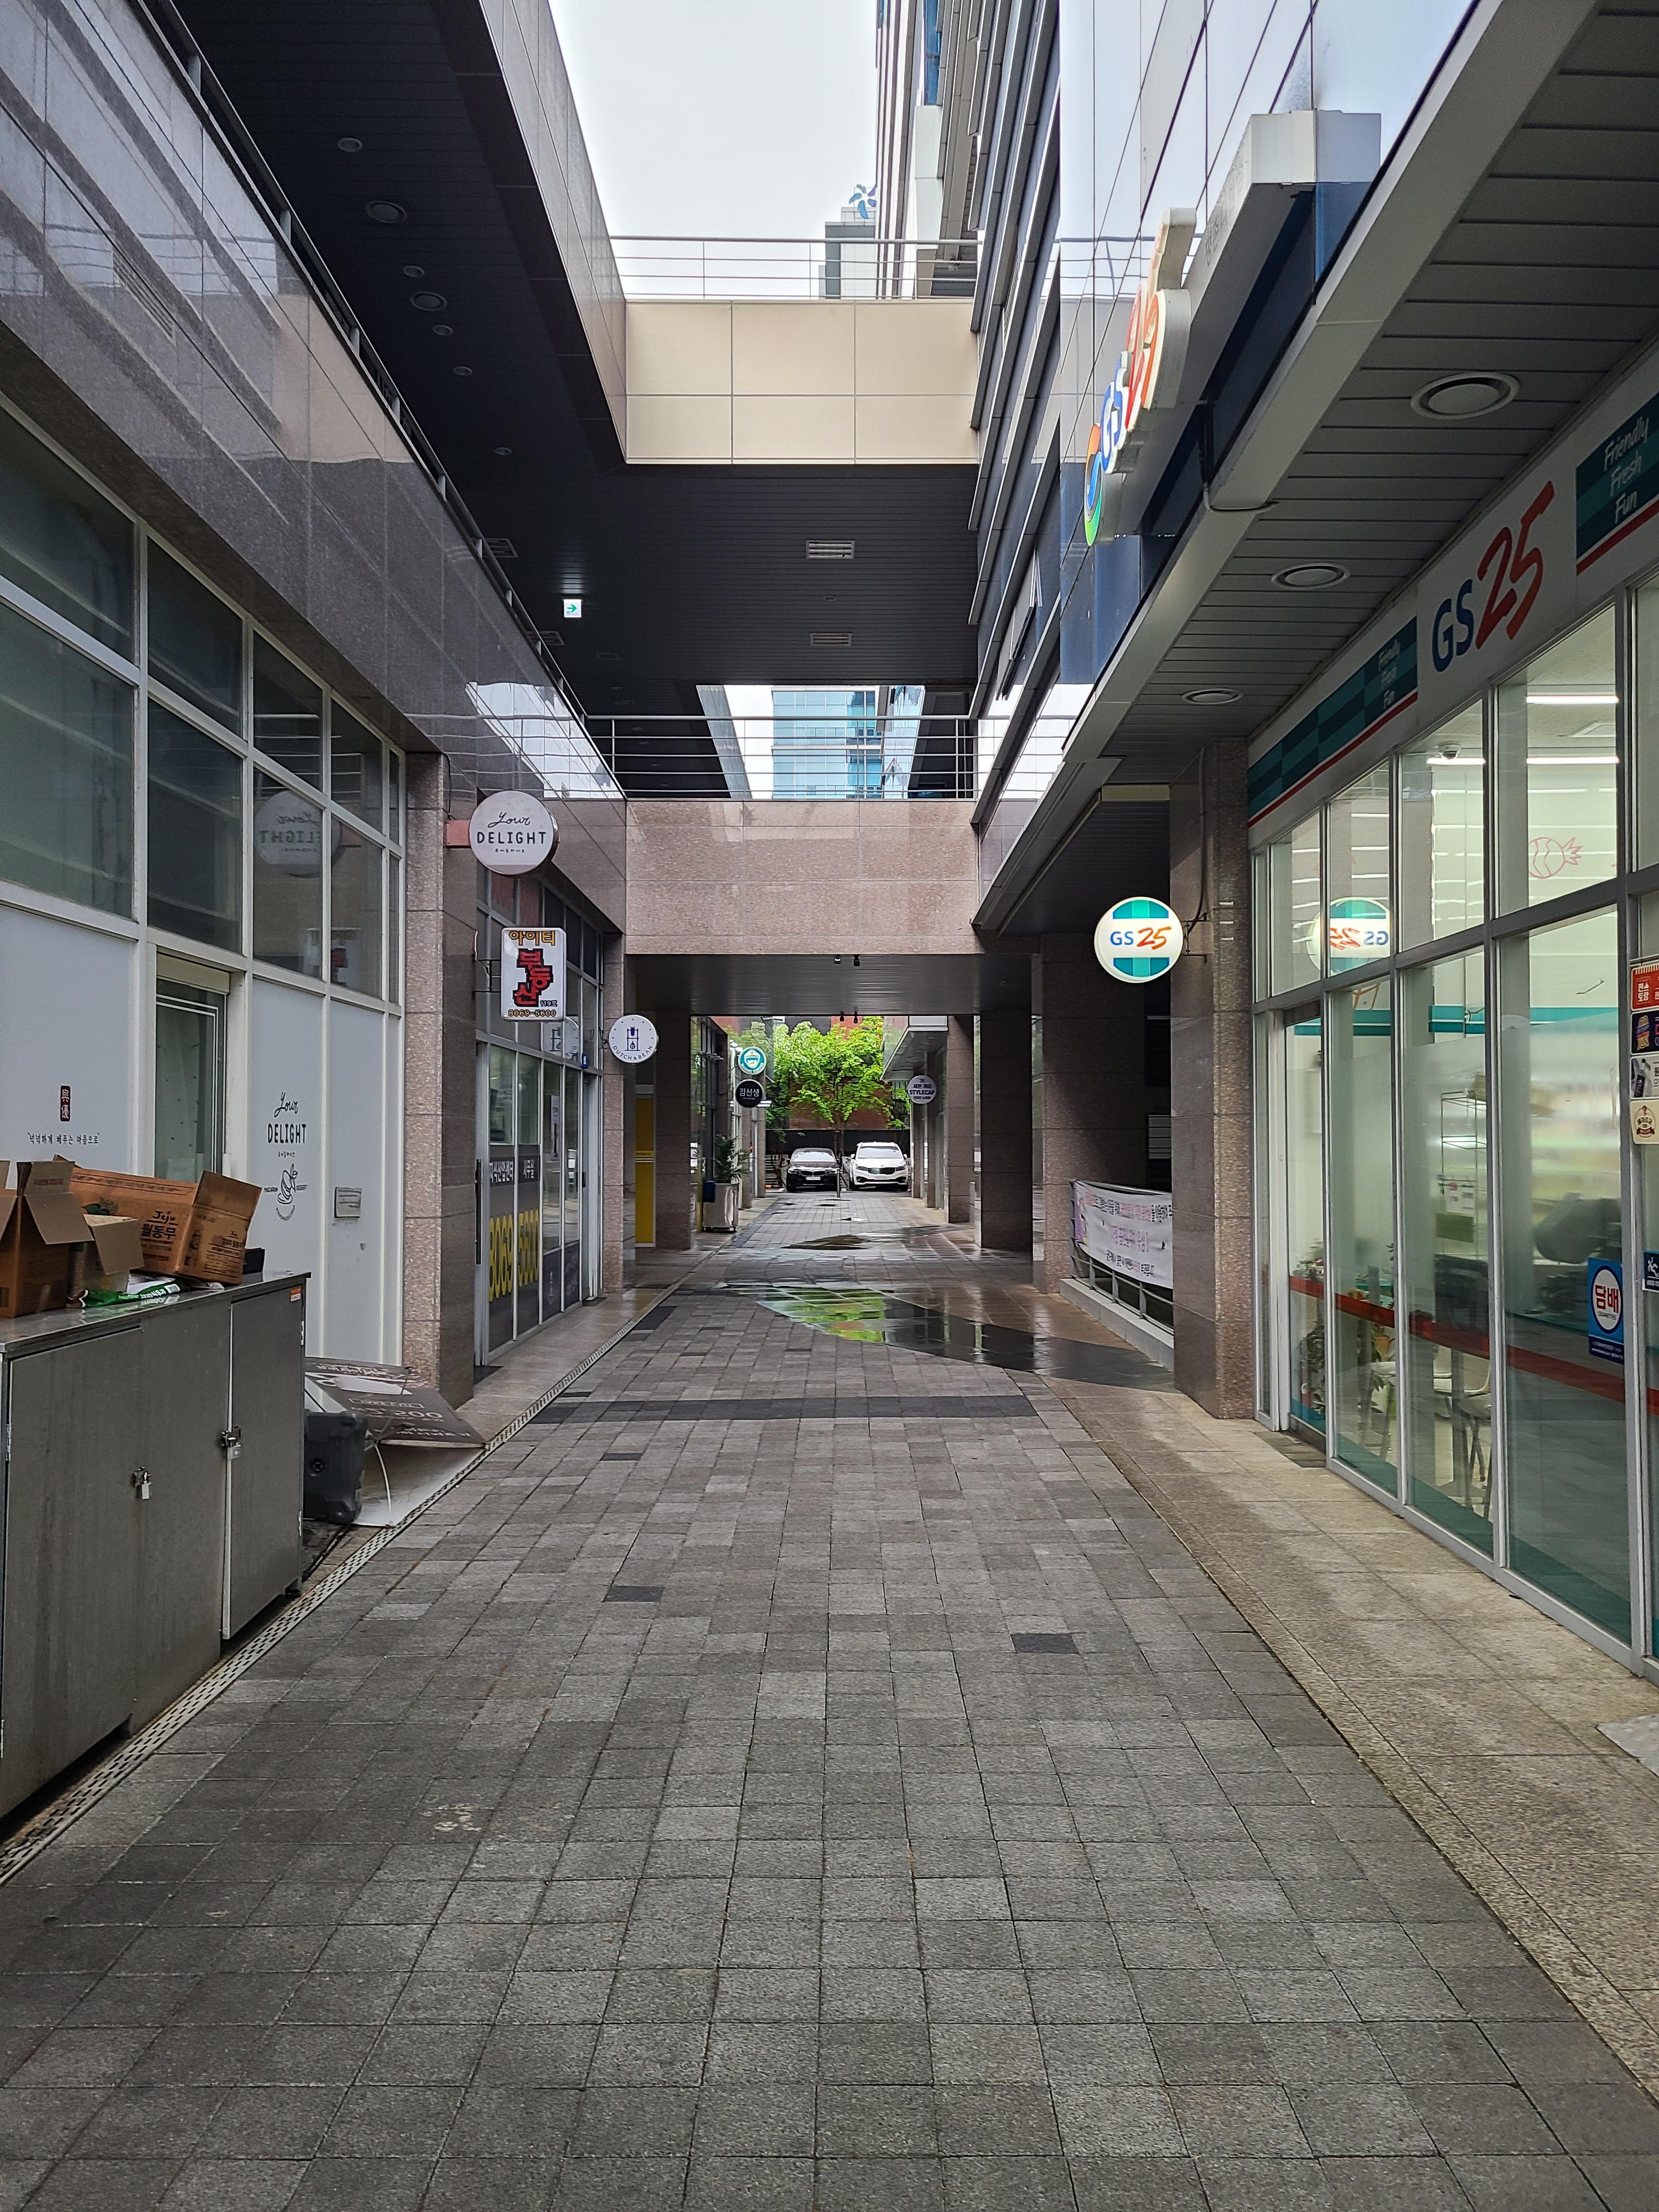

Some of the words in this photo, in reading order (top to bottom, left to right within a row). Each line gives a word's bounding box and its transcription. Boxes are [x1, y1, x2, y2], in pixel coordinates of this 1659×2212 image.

[1604, 416, 1649, 471] Friendly
[1611, 450, 1642, 496] Fresh
[1615, 491, 1637, 524] Fun
[488, 812, 531, 828] Your
[477, 832, 546, 844] DELIGHT
[509, 930, 556, 946] 아이티
[740, 1088, 759, 1097] 김선생
[274, 1092, 298, 1118] Your
[268, 1124, 306, 1143] DELIGHT
[153, 1210, 176, 1222] Jeju
[140, 1223, 176, 1239] 월동무
[1595, 1285, 1618, 1313] 담배
